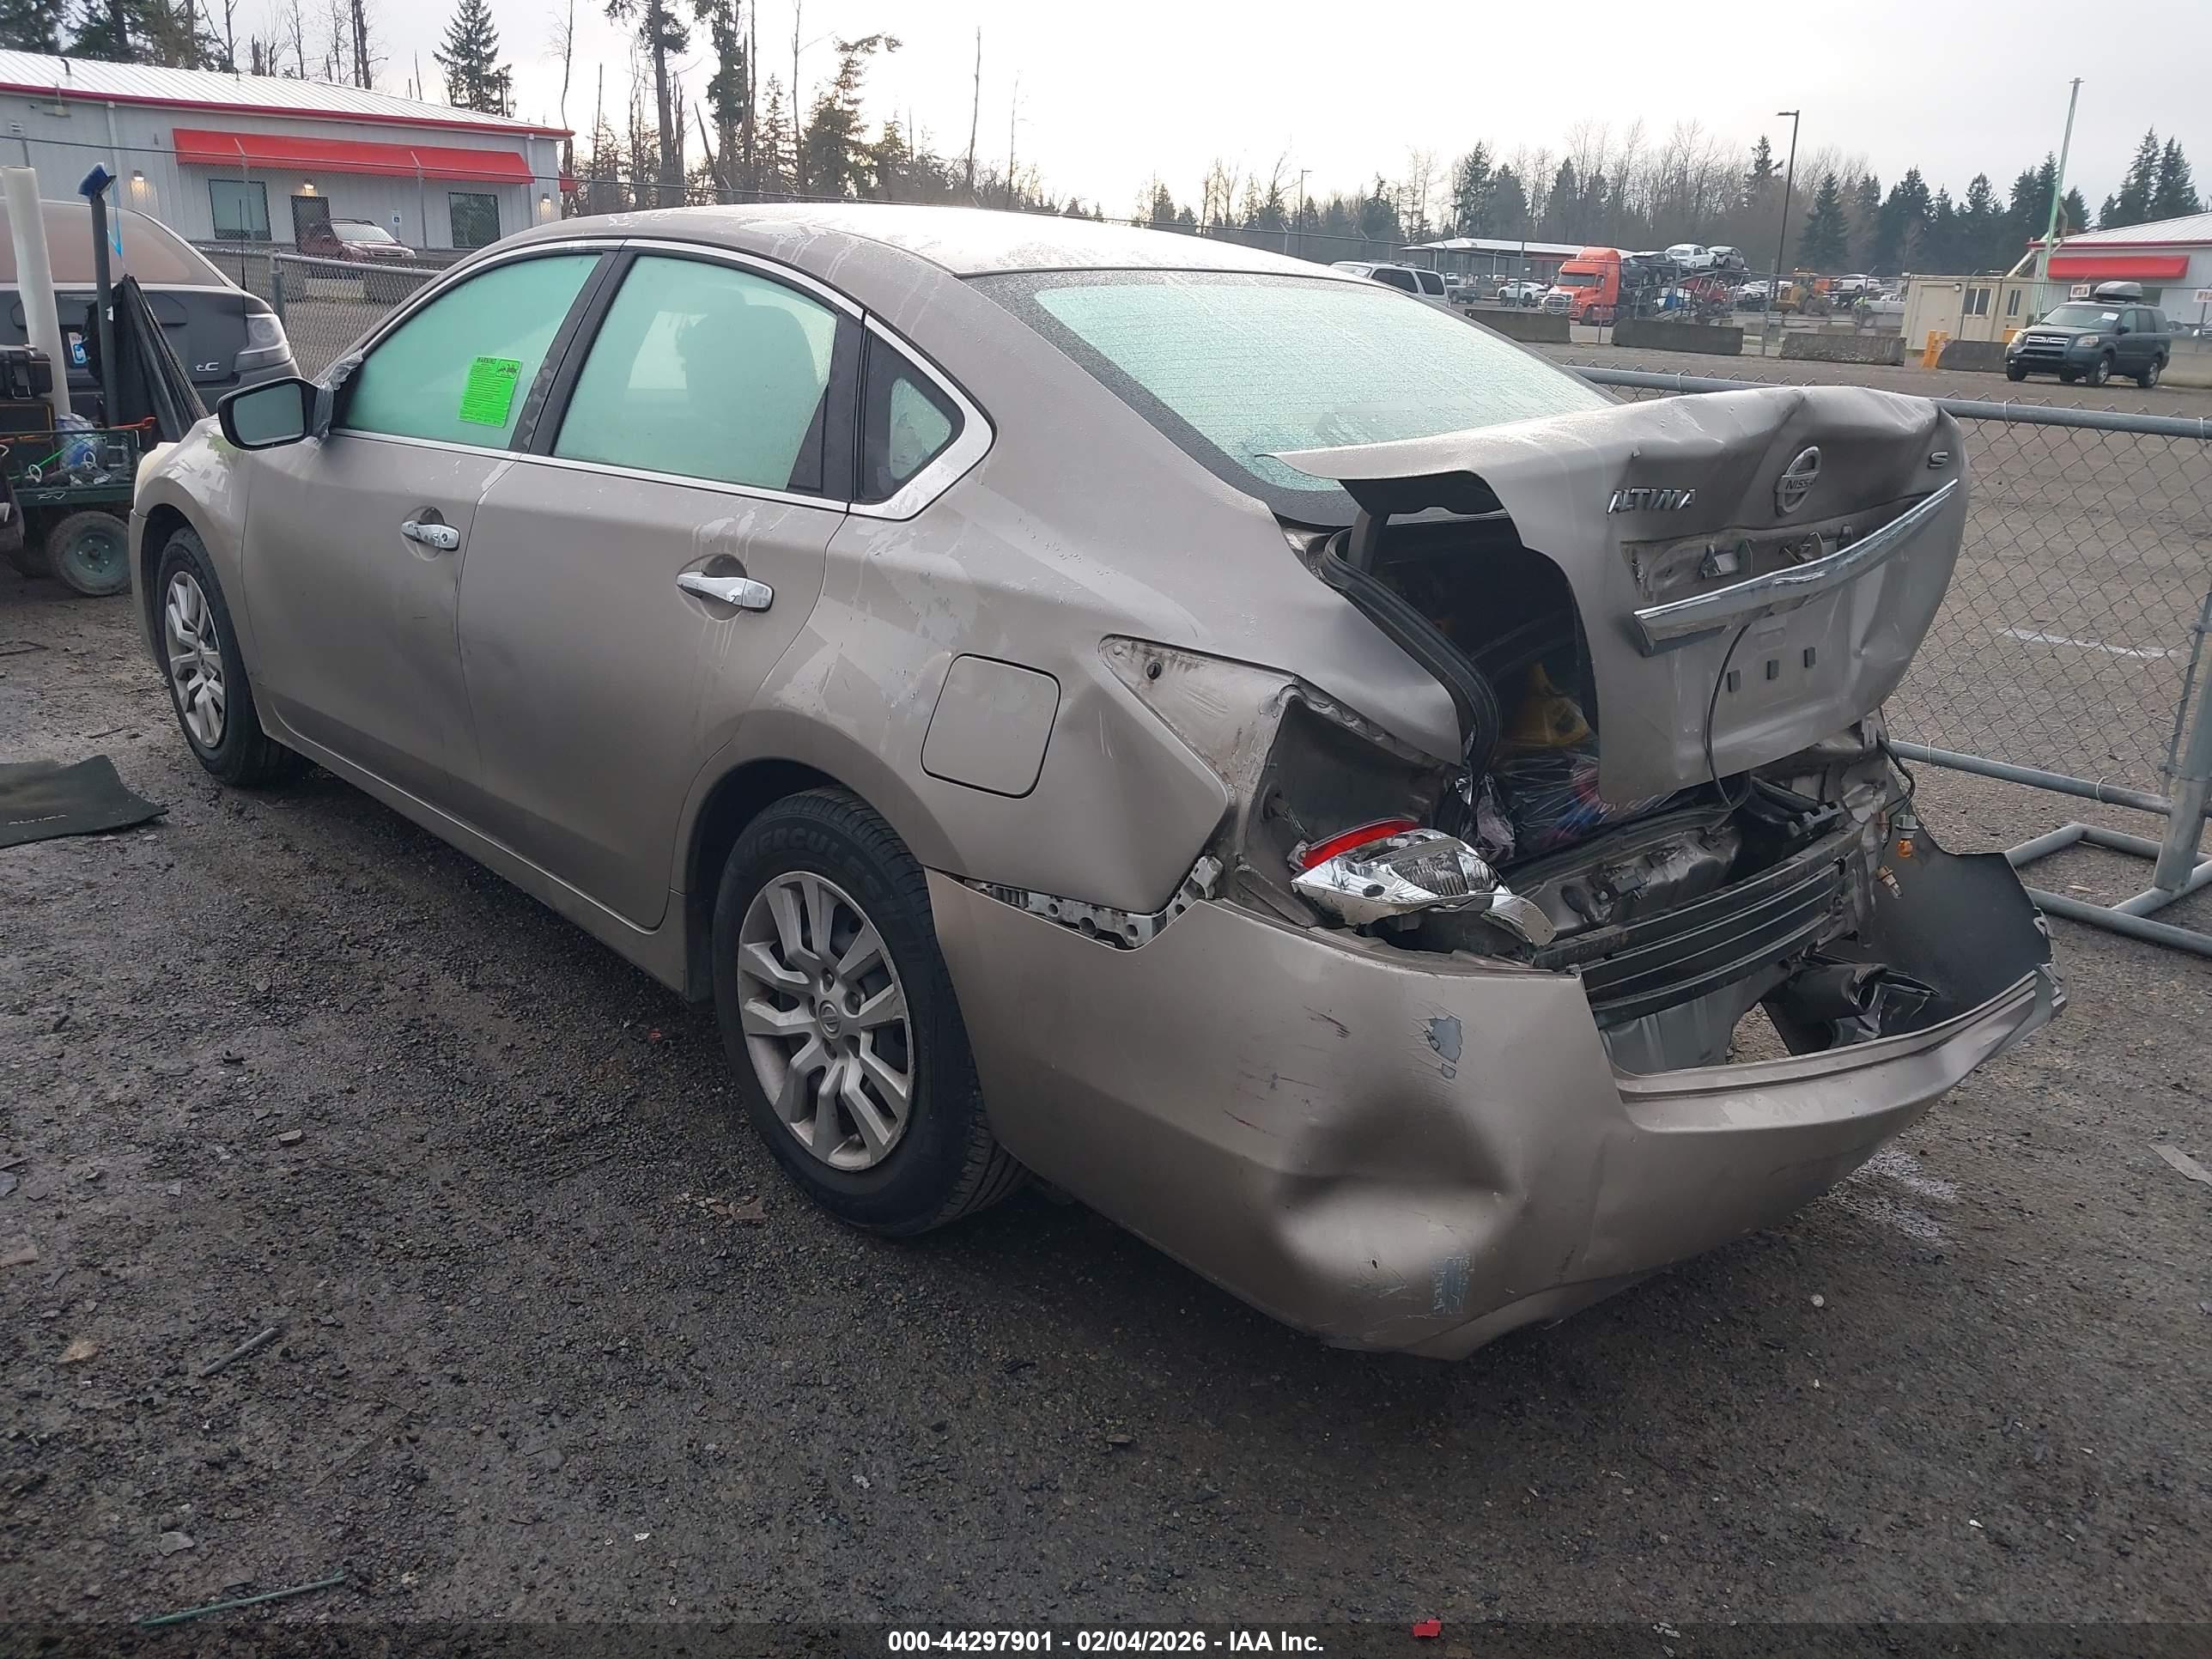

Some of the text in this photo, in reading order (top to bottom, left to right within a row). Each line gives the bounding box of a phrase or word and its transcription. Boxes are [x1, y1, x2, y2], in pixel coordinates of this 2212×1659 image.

[195, 362, 220, 372] tC
[1928, 451, 1949, 469] S
[1607, 488, 1697, 514] ALTIMA
